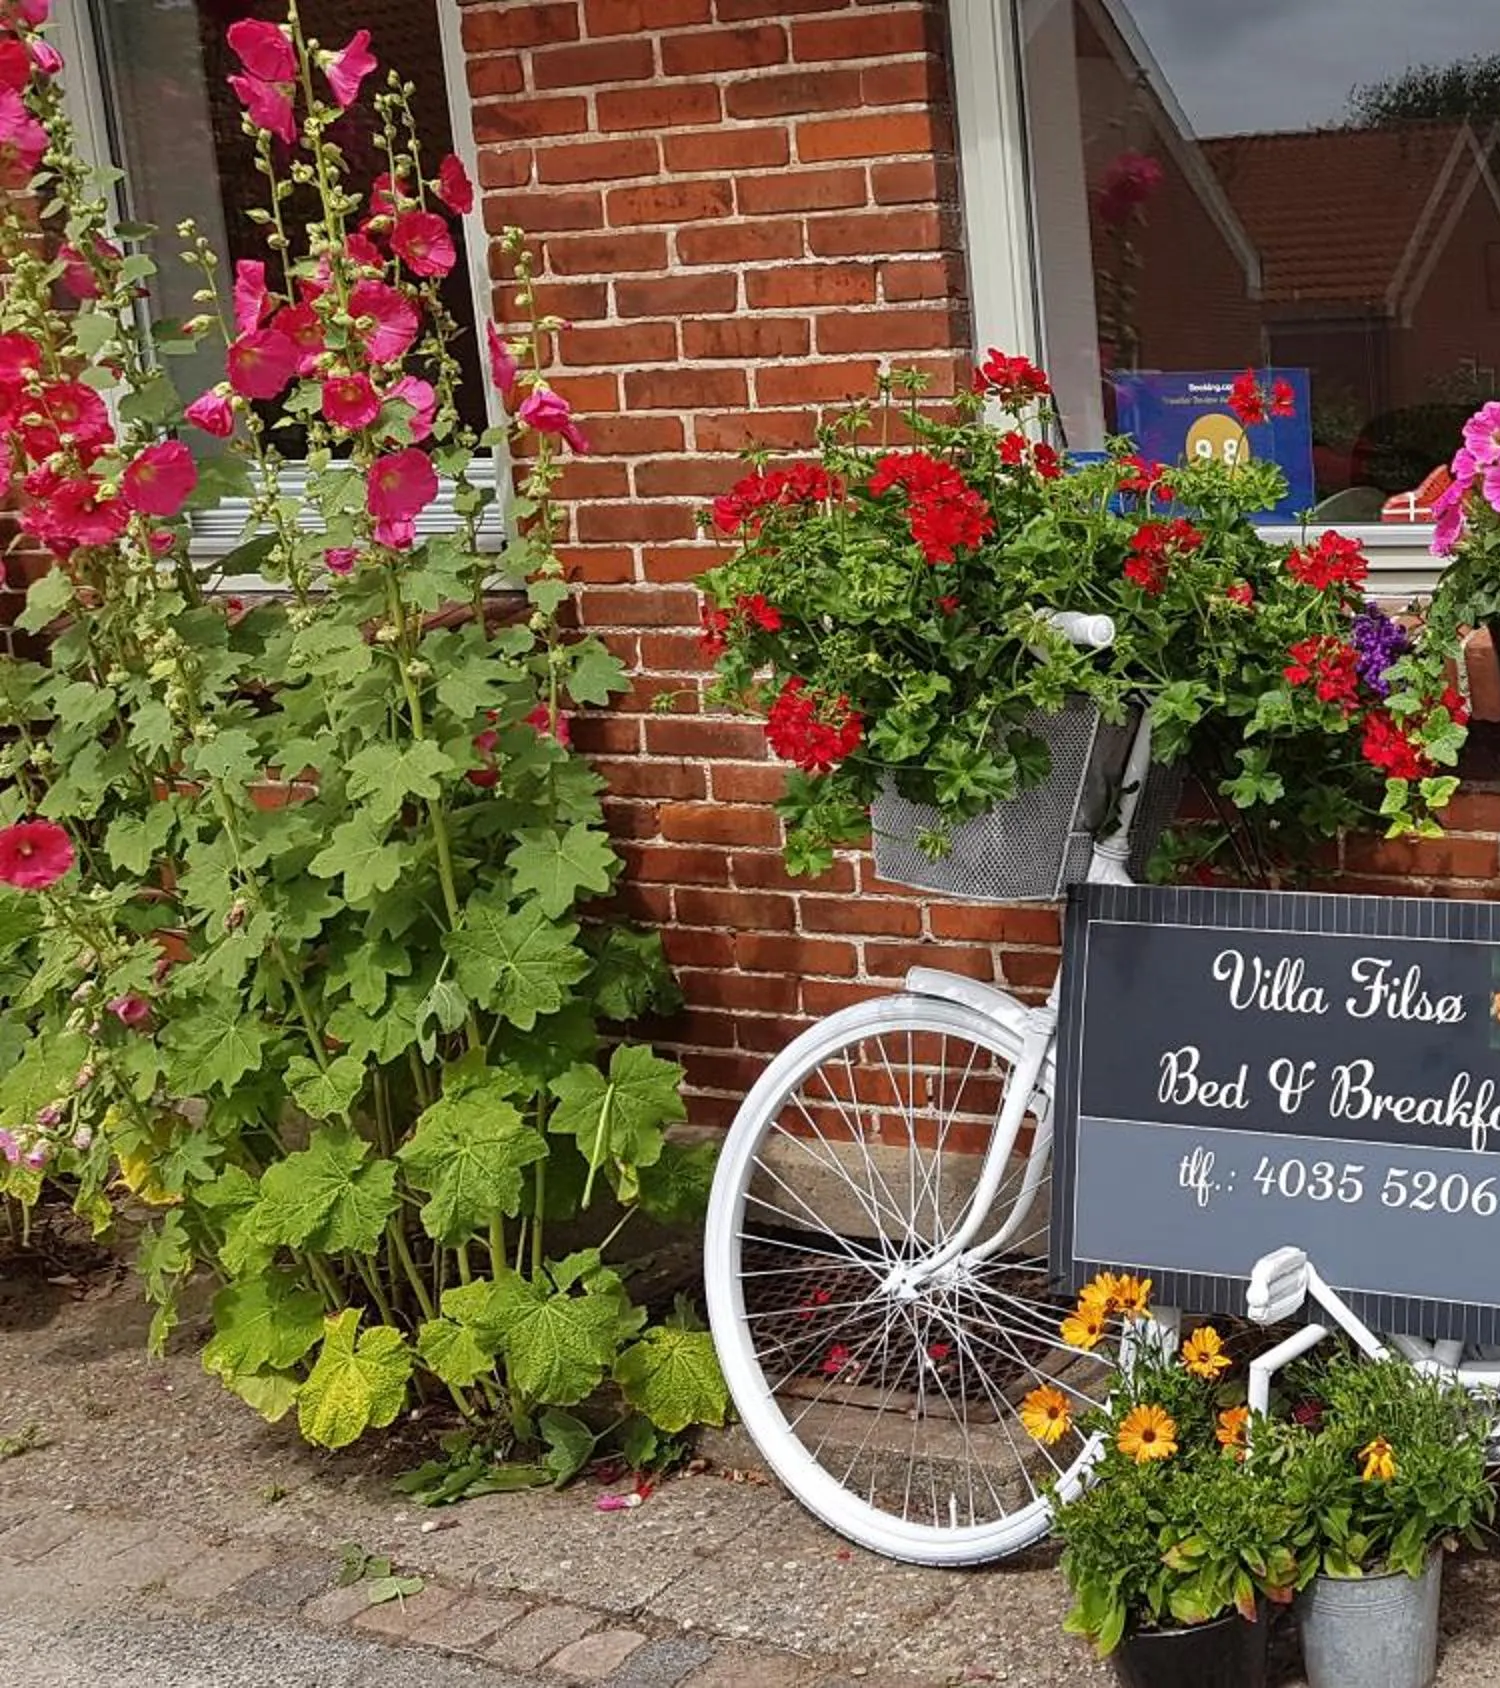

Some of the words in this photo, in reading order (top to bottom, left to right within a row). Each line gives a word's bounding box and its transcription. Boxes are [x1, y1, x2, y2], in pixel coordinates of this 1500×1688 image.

[1212, 949, 1329, 1014] Villa
[1345, 957, 1467, 1024] Filsø
[1158, 1046, 1249, 1109] Bed
[1268, 1058, 1317, 1114] &
[1179, 1146, 1236, 1208] tlf.:
[1253, 1156, 1365, 1203] 4035
[1381, 1167, 1498, 1217] 5206
